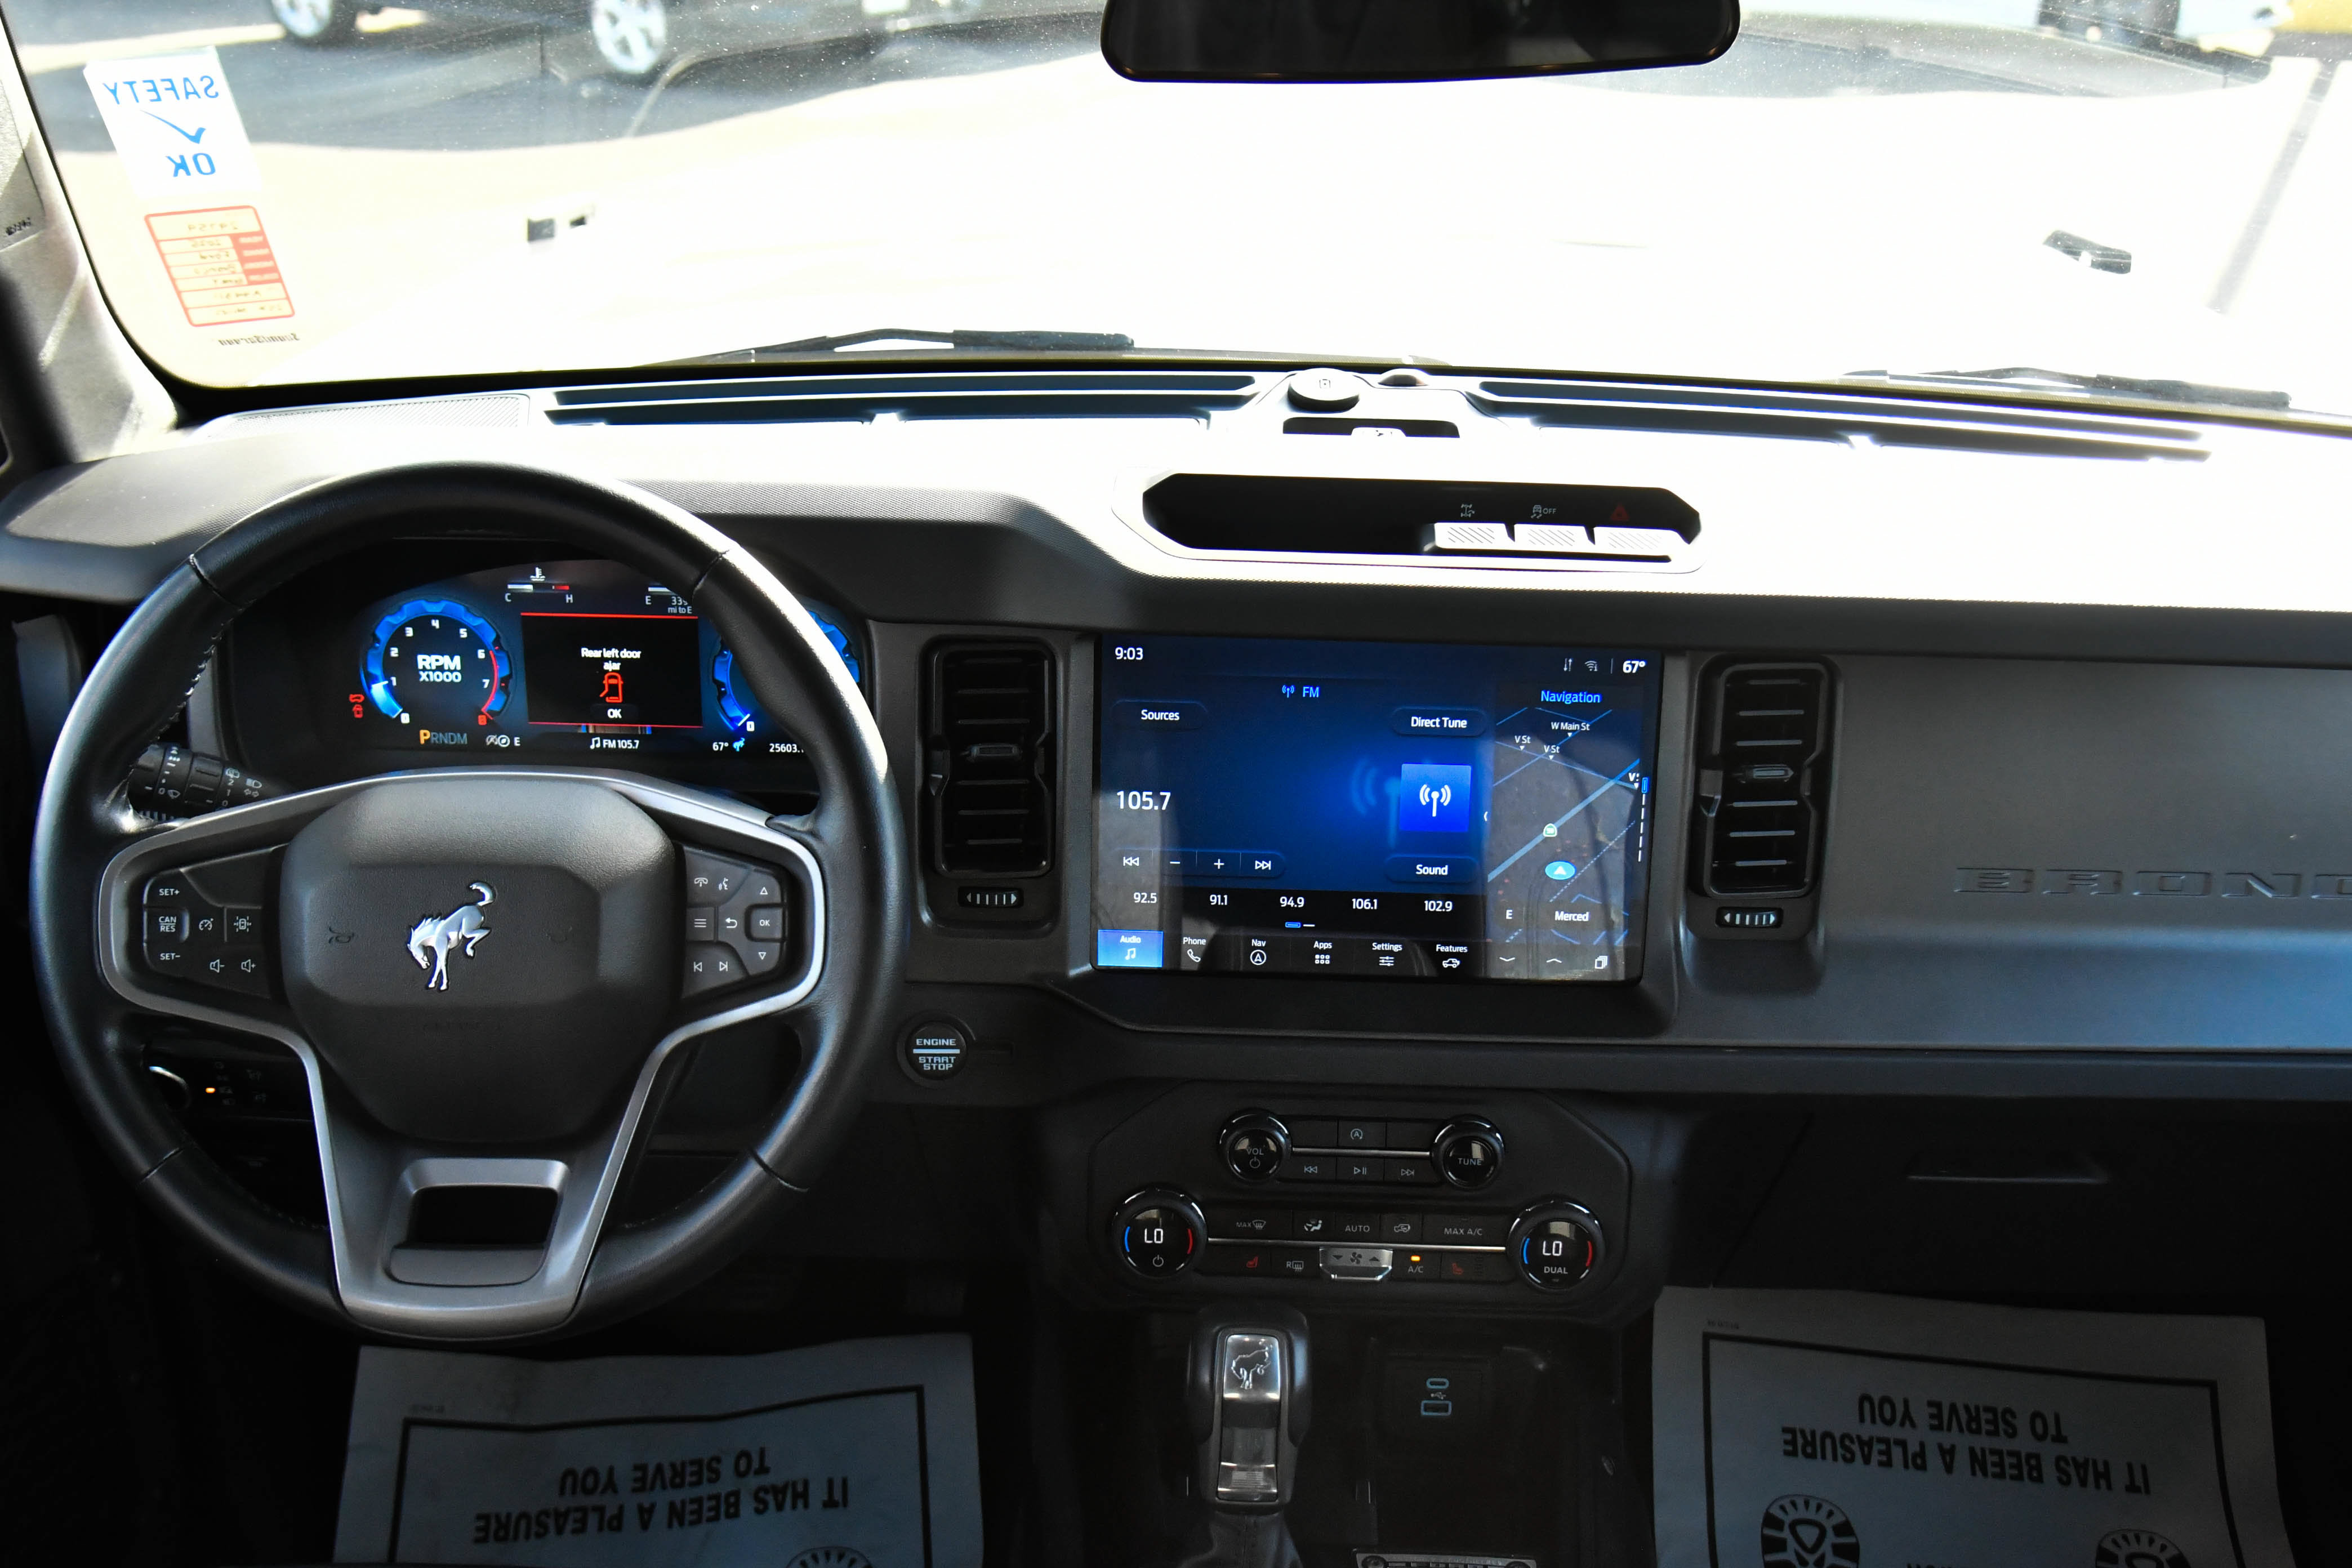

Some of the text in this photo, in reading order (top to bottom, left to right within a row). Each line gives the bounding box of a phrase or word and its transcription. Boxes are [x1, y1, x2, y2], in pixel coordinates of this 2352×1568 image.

[505, 593, 511, 602] C
[566, 594, 573, 603] H
[645, 596, 651, 604] E
[431, 620, 439, 629] 4
[406, 627, 413, 636] 3
[460, 629, 467, 638] 5
[390, 648, 398, 657] 2
[478, 649, 485, 658] 6
[581, 648, 641, 658] Rear left door
[1115, 647, 1143, 660] 9:03
[417, 654, 461, 670] RPM
[604, 661, 621, 671] ajar
[1623, 661, 1645, 673] 67°
[391, 677, 397, 686] 1
[419, 671, 461, 682] X1000
[483, 679, 489, 688] 7
[1303, 687, 1319, 697] FM
[1541, 691, 1601, 704] Navigation
[401, 713, 410, 724] 0
[608, 709, 622, 718] OK
[1141, 710, 1179, 720] Sources
[746, 721, 754, 731] 0
[1411, 716, 1467, 728] Direct Tune
[514, 737, 520, 746] E
[603, 740, 639, 749] FM 105.7
[713, 742, 728, 751] 67°
[769, 743, 804, 753] 25603.
[1115, 791, 1170, 810] 105.7
[1416, 865, 1448, 875] Sound
[1134, 893, 1157, 903] 92.5
[1210, 894, 1227, 905] 91.1
[1280, 897, 1304, 907] 94.9
[1352, 898, 1377, 909] 106.1
[1424, 901, 1453, 911] 102.9
[1506, 910, 1512, 919] E
[1555, 911, 1589, 921] Merced
[1120, 936, 1141, 944] Audio
[1183, 937, 1206, 946] Phone
[1314, 941, 1332, 950] Apps
[1373, 943, 1402, 952] Settings
[1144, 1228, 1163, 1243] LO
[1543, 1241, 1562, 1256] LO
[1858, 1393, 2068, 1443] TO SERVE YOU
[1783, 1427, 2150, 1495] IT HAS BEEN A PLEASURE
[559, 1447, 770, 1496] TO SERVE YOU
[474, 1477, 848, 1543] IT HAS BEEN A PLEASURE
